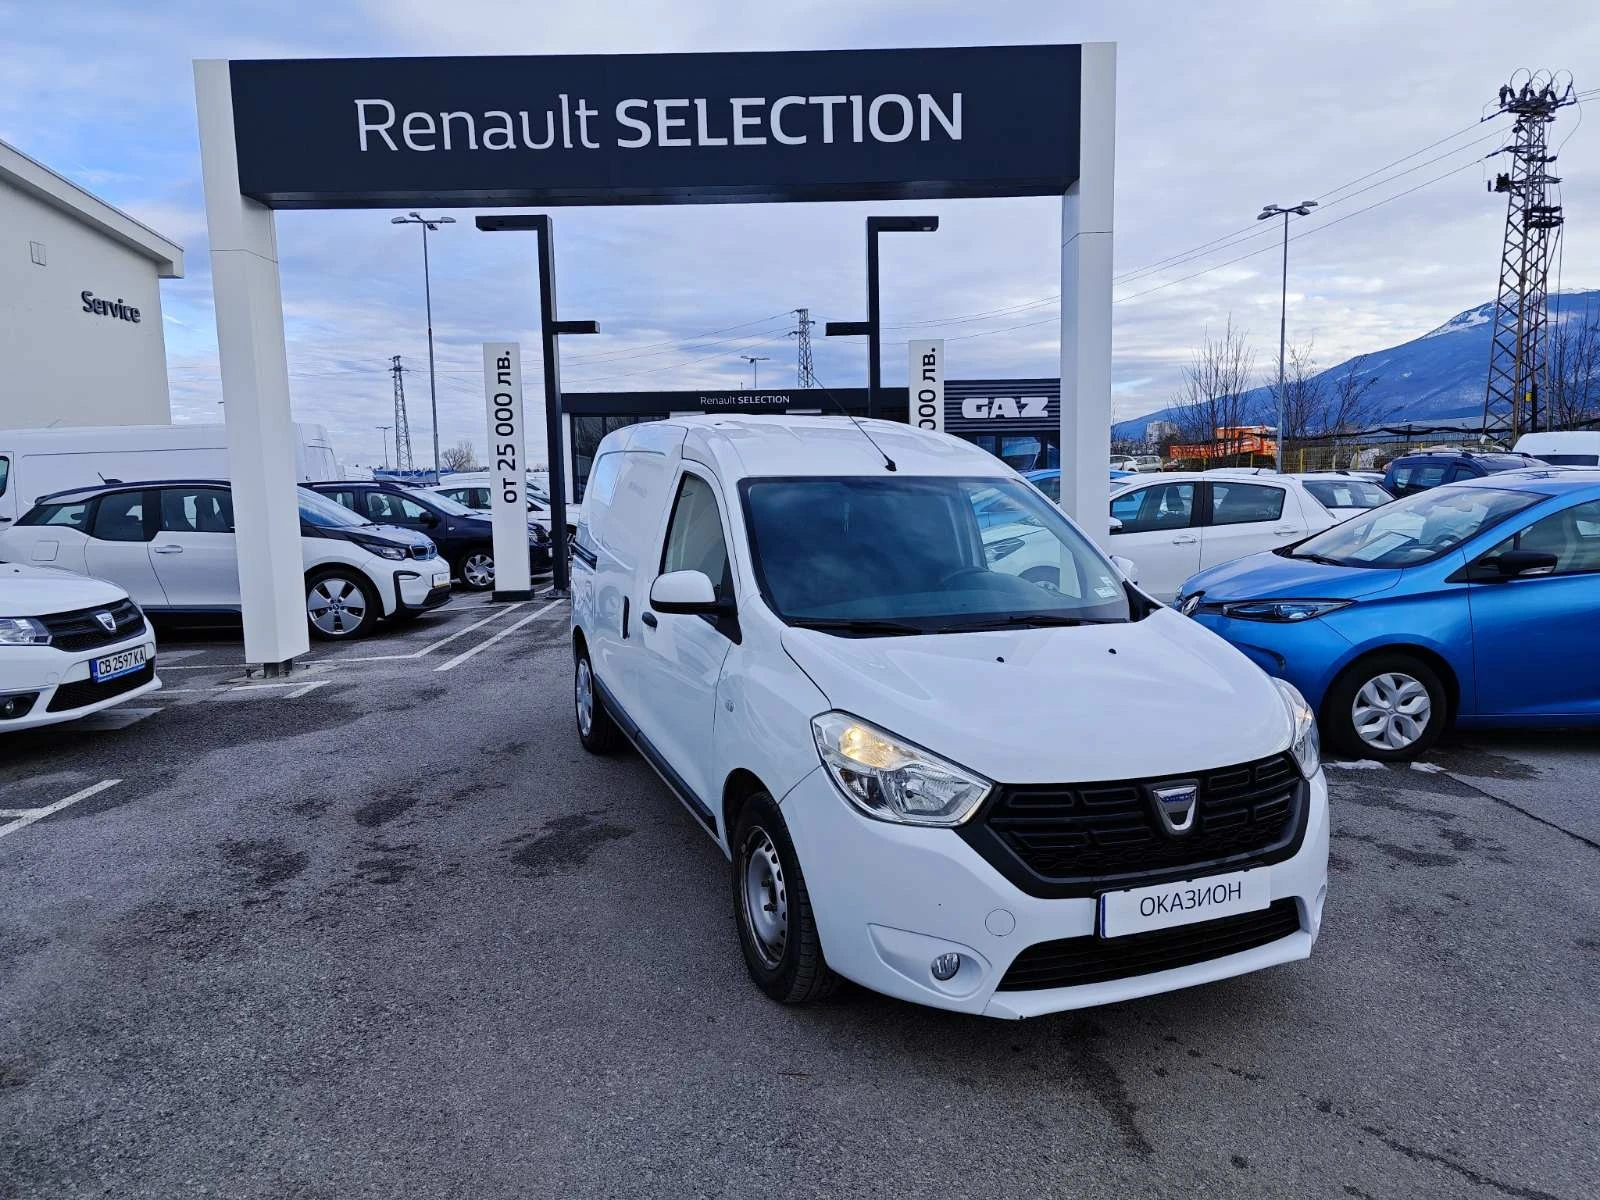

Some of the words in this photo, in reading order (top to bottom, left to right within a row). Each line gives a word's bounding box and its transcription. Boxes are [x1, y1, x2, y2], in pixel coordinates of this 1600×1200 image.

[354, 93, 600, 152] Renault
[617, 92, 963, 148] SELECTION
[81, 290, 141, 323] Service
[497, 351, 511, 386] лв.
[923, 347, 936, 382] лв.
[494, 393, 514, 437] 000
[700, 396, 735, 405] Renault
[738, 395, 790, 404] SELECTION
[961, 397, 1049, 419] GAZ
[497, 444, 516, 471] 25
[99, 659, 111, 675] CB
[113, 652, 133, 671] 2597
[1140, 881, 1241, 917] ОКАЗИОН
